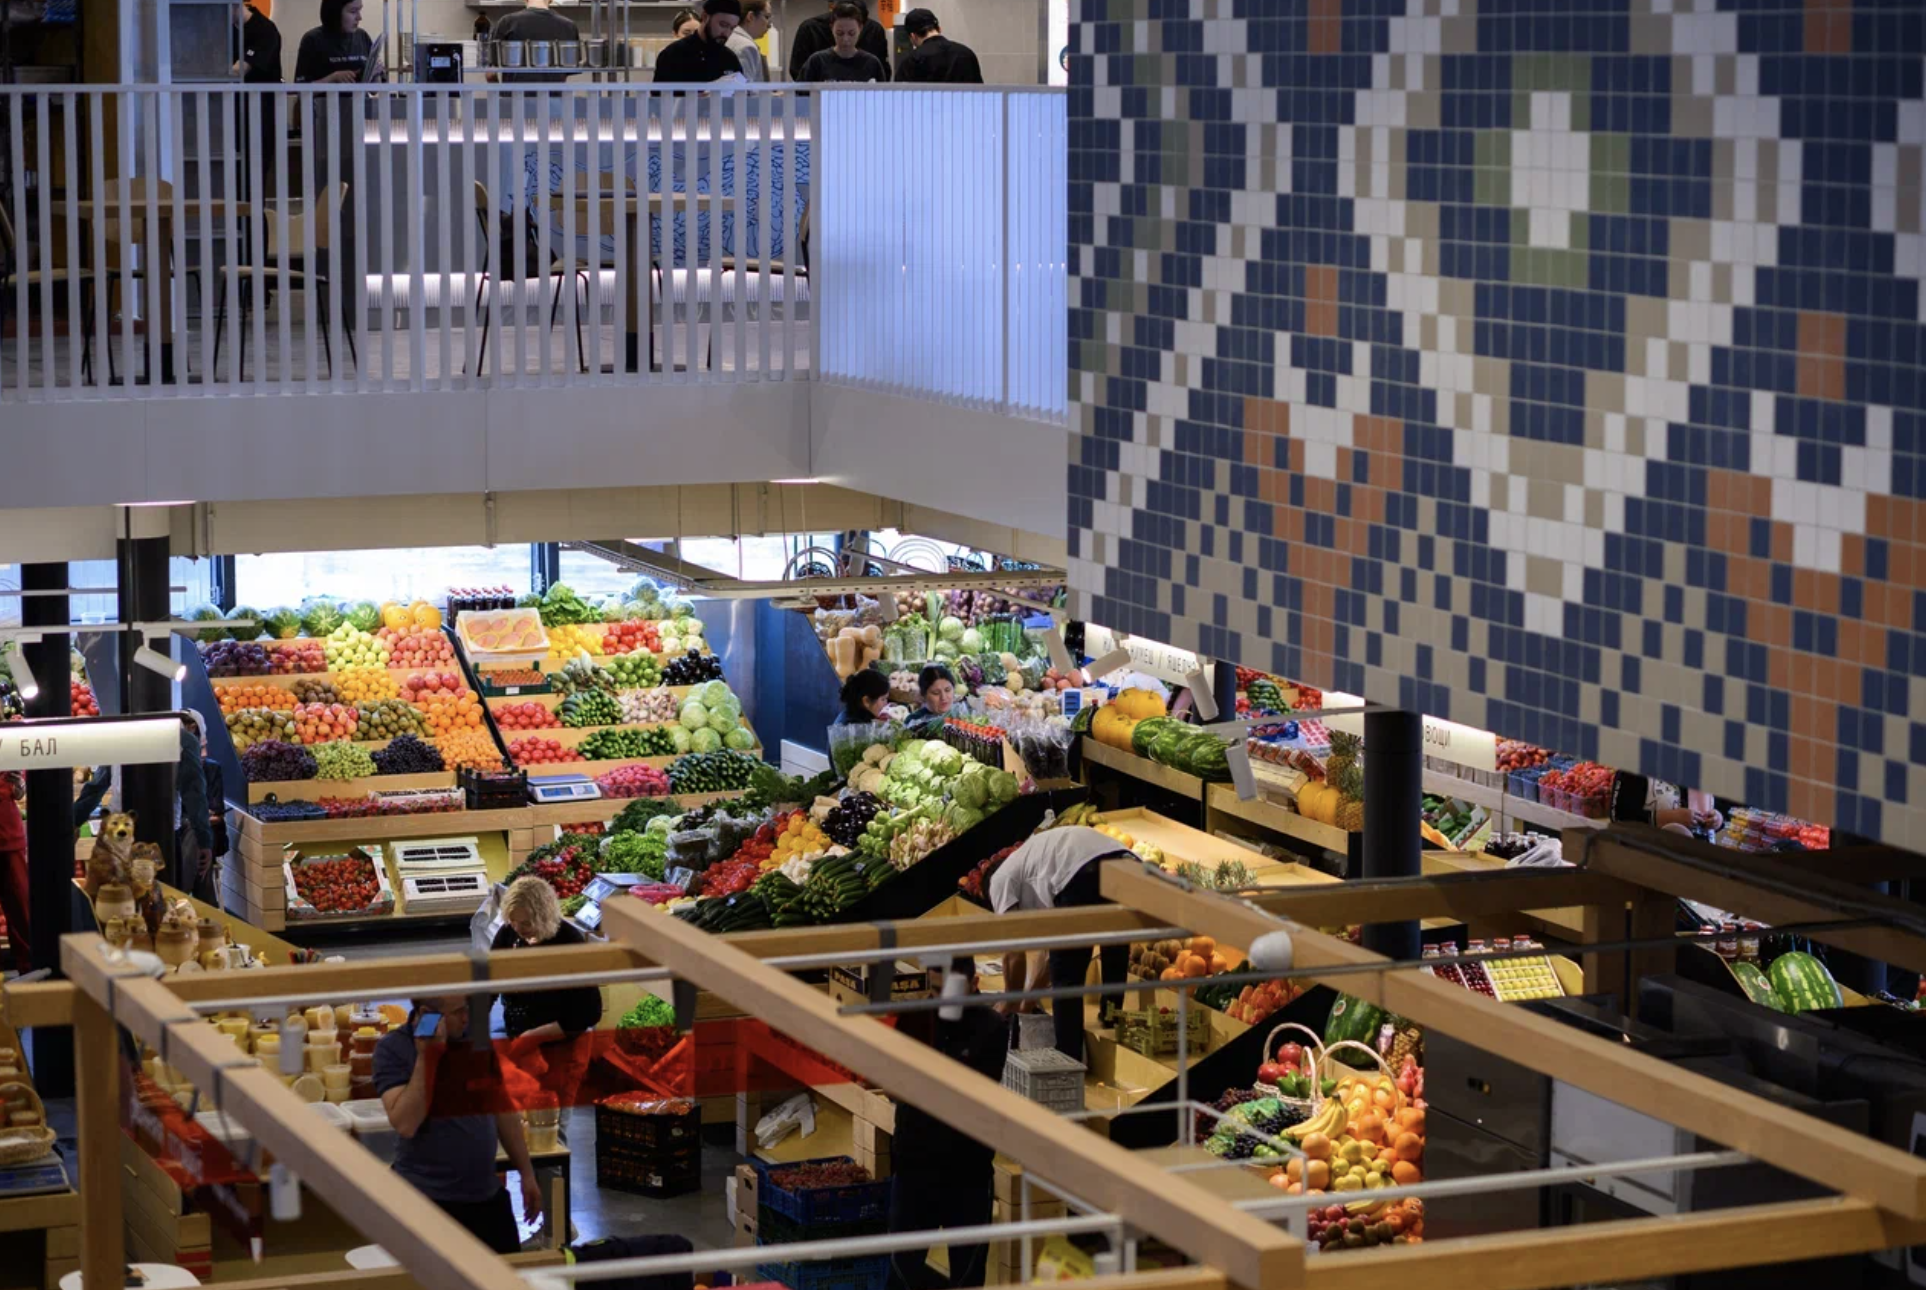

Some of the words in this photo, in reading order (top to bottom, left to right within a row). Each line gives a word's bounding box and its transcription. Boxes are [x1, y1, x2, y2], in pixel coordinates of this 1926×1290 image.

[1422, 725, 1451, 749] ВОЩИ
[20, 738, 57, 757] БАЛ
[891, 979, 920, 993] AŞA
